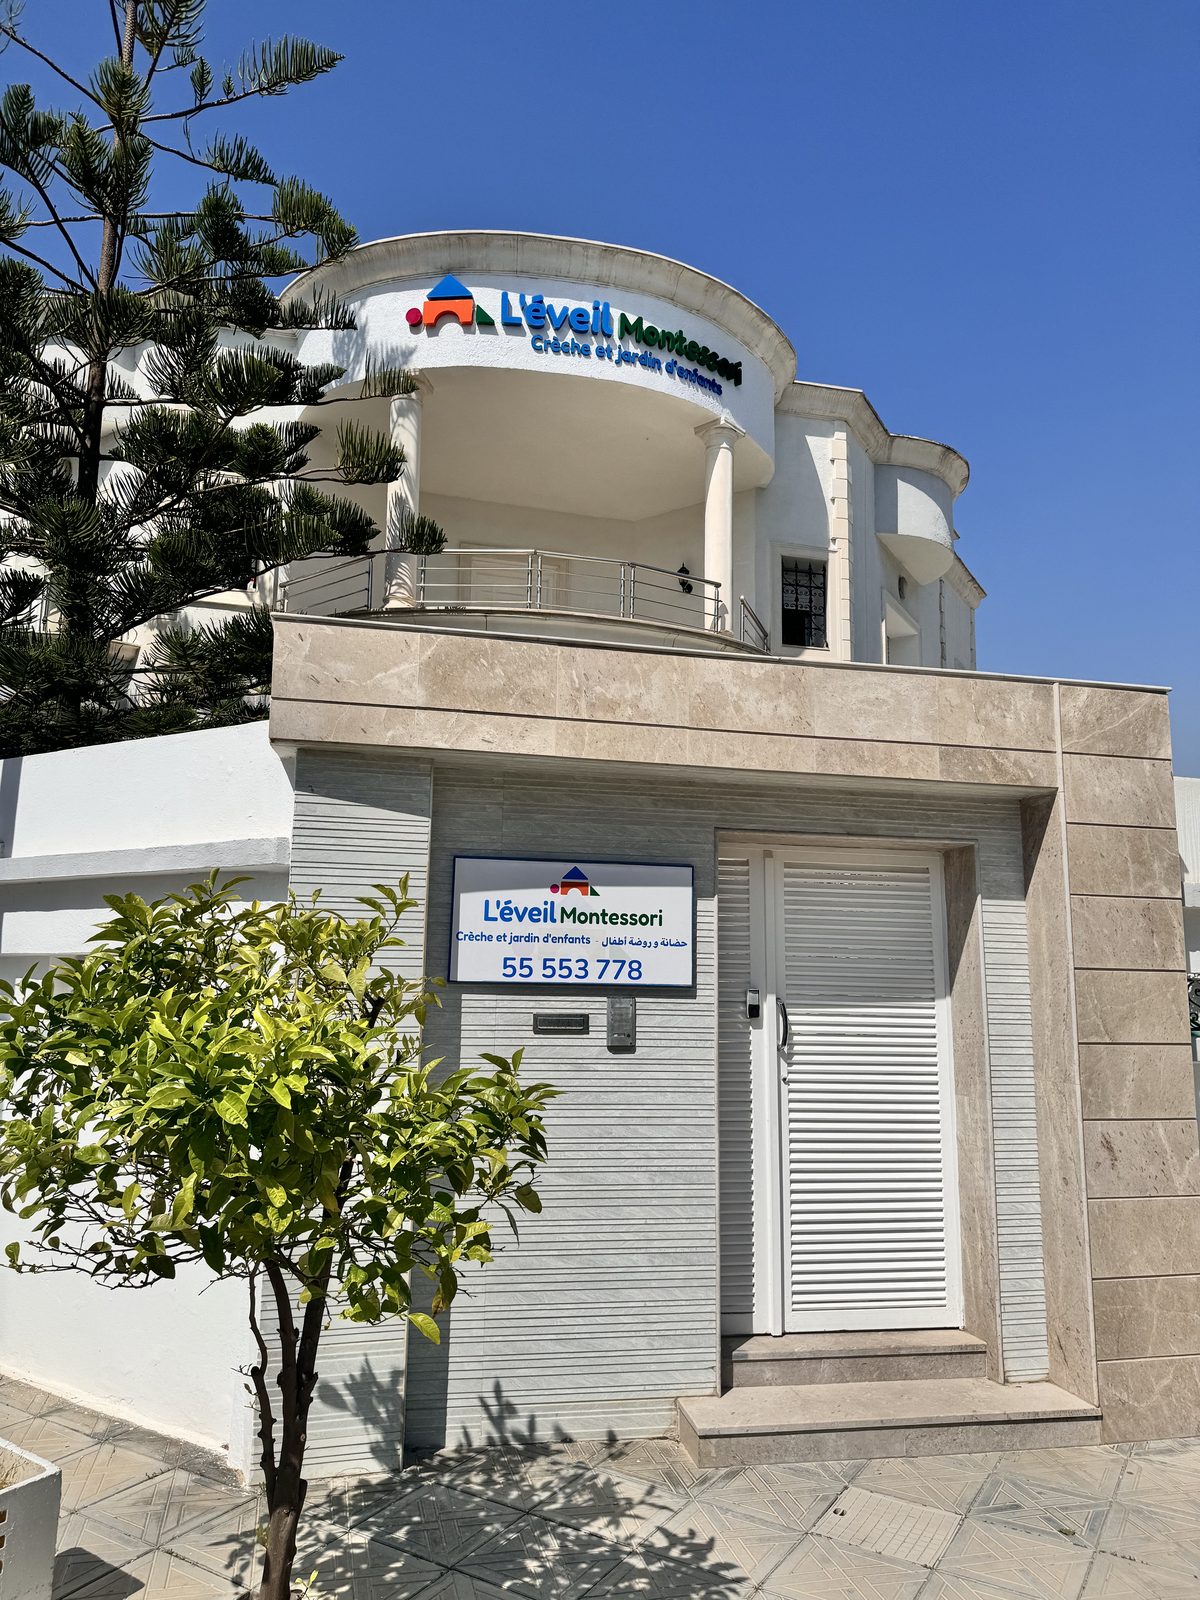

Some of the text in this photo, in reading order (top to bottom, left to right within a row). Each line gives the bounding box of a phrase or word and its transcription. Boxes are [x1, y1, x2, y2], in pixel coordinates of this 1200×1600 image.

[501, 291, 613, 336] L'éveil
[531, 334, 723, 396] Crèche et jardin d'enfants
[484, 899, 663, 926] L'éveil Montessori
[456, 931, 591, 944] Crèche et jardin d'enfants
[601, 936, 628, 948] أطفال
[628, 938, 652, 949] روضة
[660, 939, 688, 948] حضانة
[502, 957, 643, 980] 55 553 778
